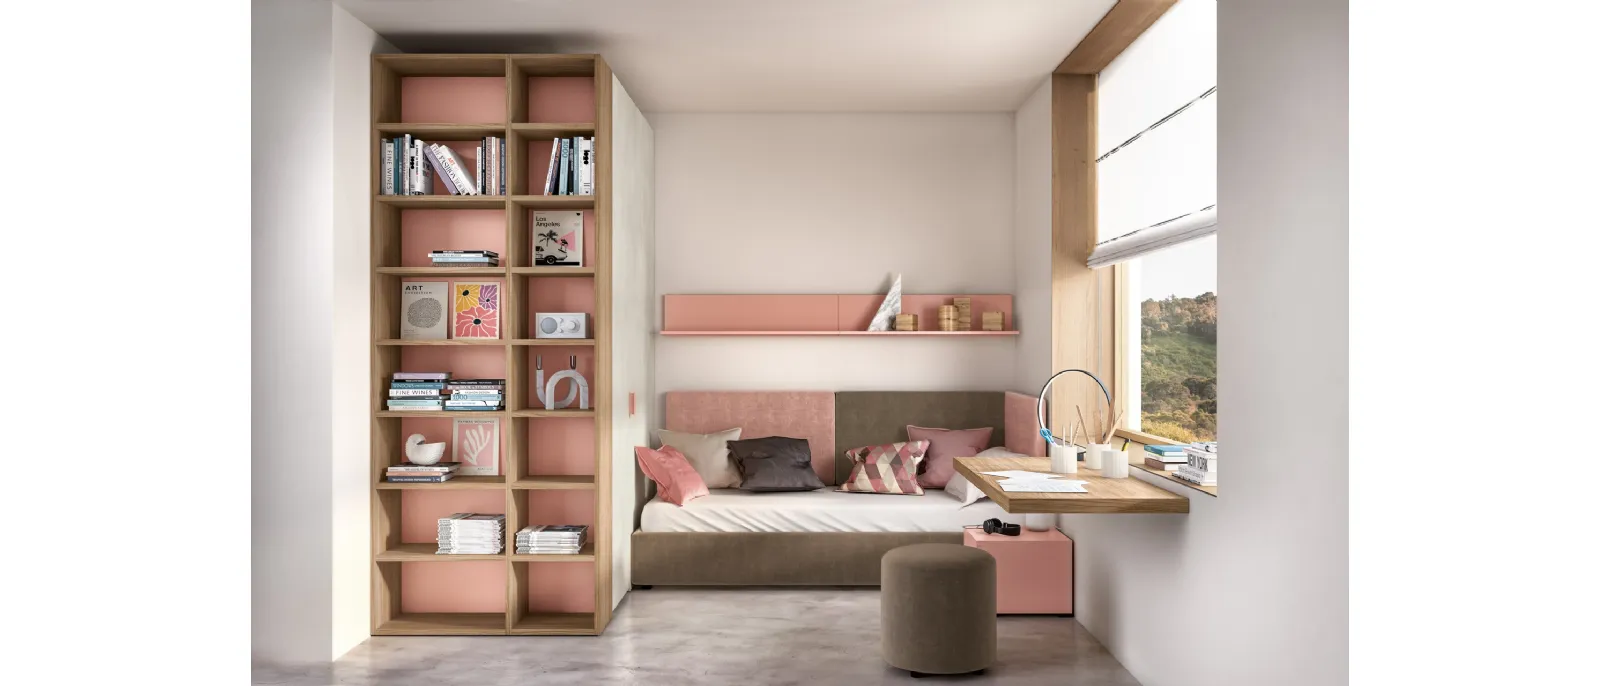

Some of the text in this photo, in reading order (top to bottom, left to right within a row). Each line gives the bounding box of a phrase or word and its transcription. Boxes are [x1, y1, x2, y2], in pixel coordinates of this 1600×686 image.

[437, 154, 458, 180] FASHION
[1187, 453, 1208, 472] NEW YORK
